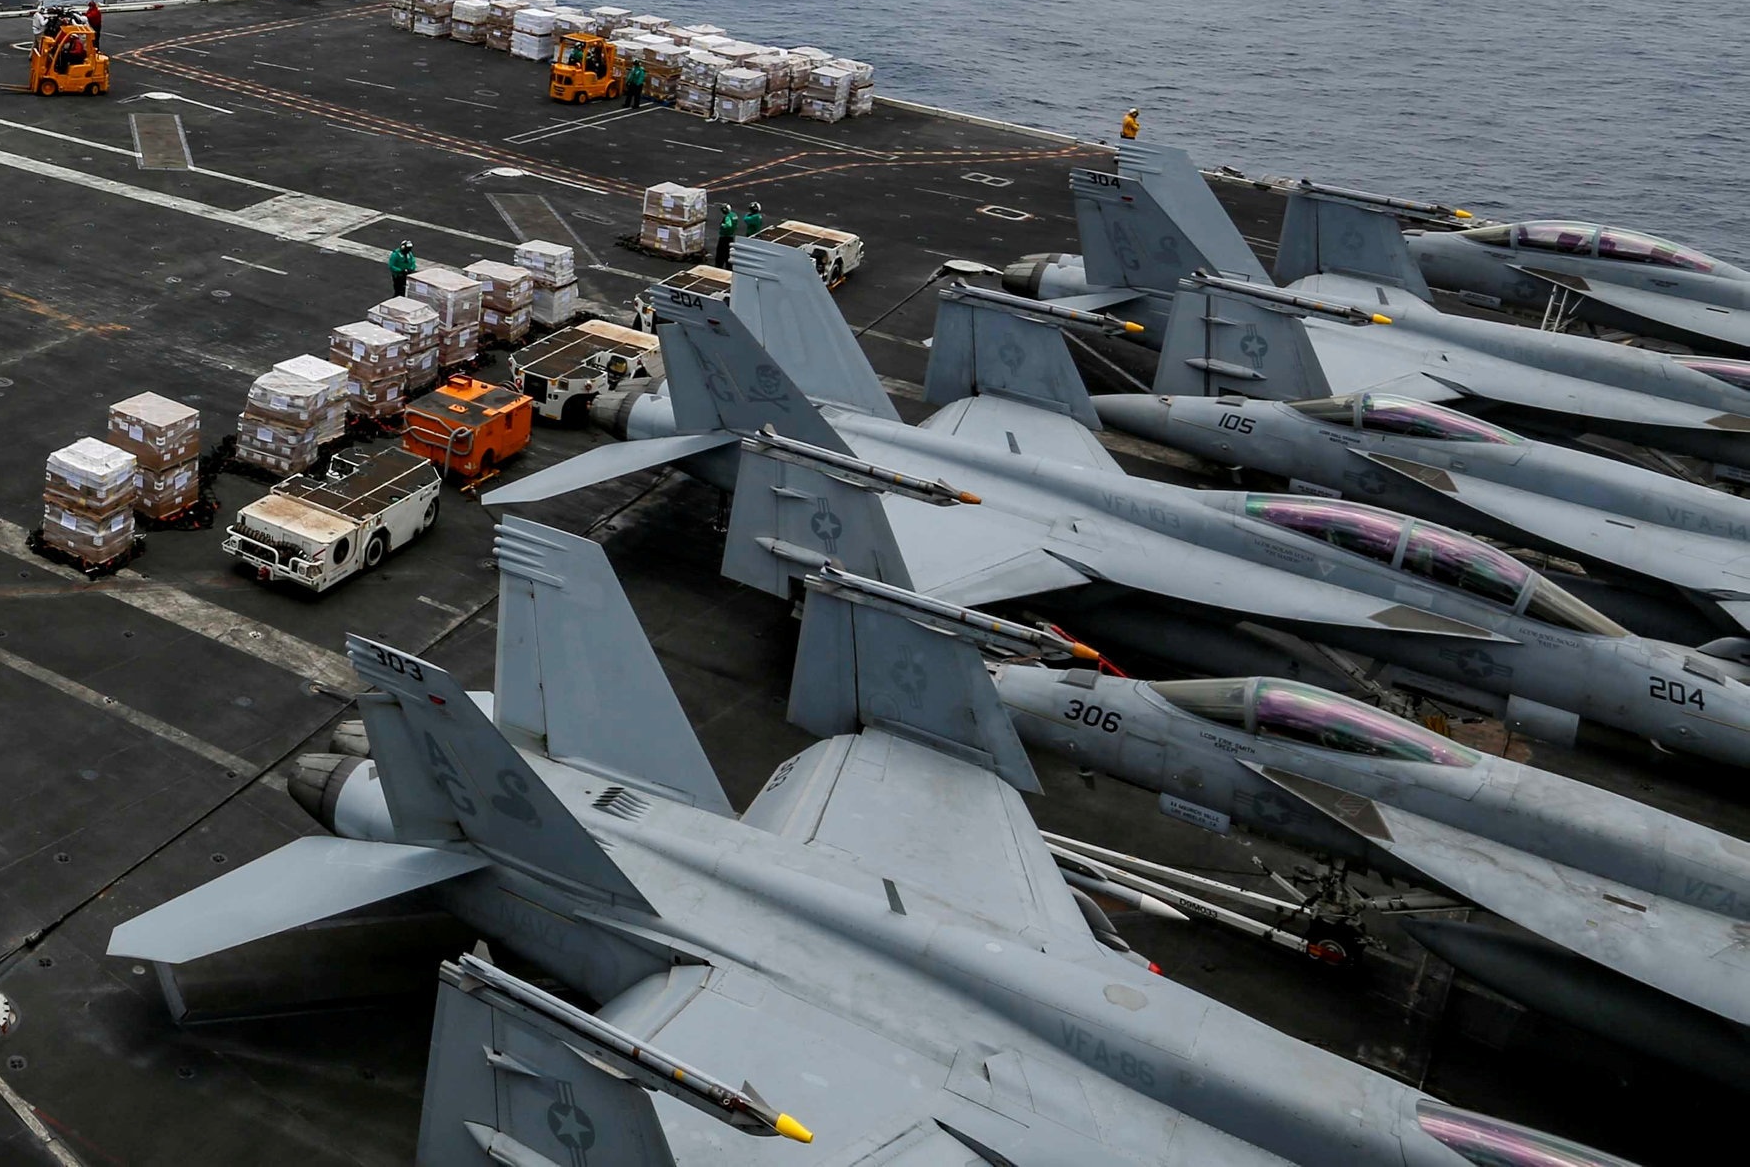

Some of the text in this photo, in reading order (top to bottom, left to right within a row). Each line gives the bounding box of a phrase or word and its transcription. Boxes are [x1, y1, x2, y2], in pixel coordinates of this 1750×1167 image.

[1086, 172, 1121, 189] 304
[670, 289, 703, 311] 204
[1218, 412, 1257, 434] 105
[1102, 491, 1181, 530] VFA-103
[370, 644, 424, 682] 303
[1649, 676, 1706, 711] 204
[1063, 699, 1123, 734] 306
[1060, 1019, 1155, 1088] VFA-86
